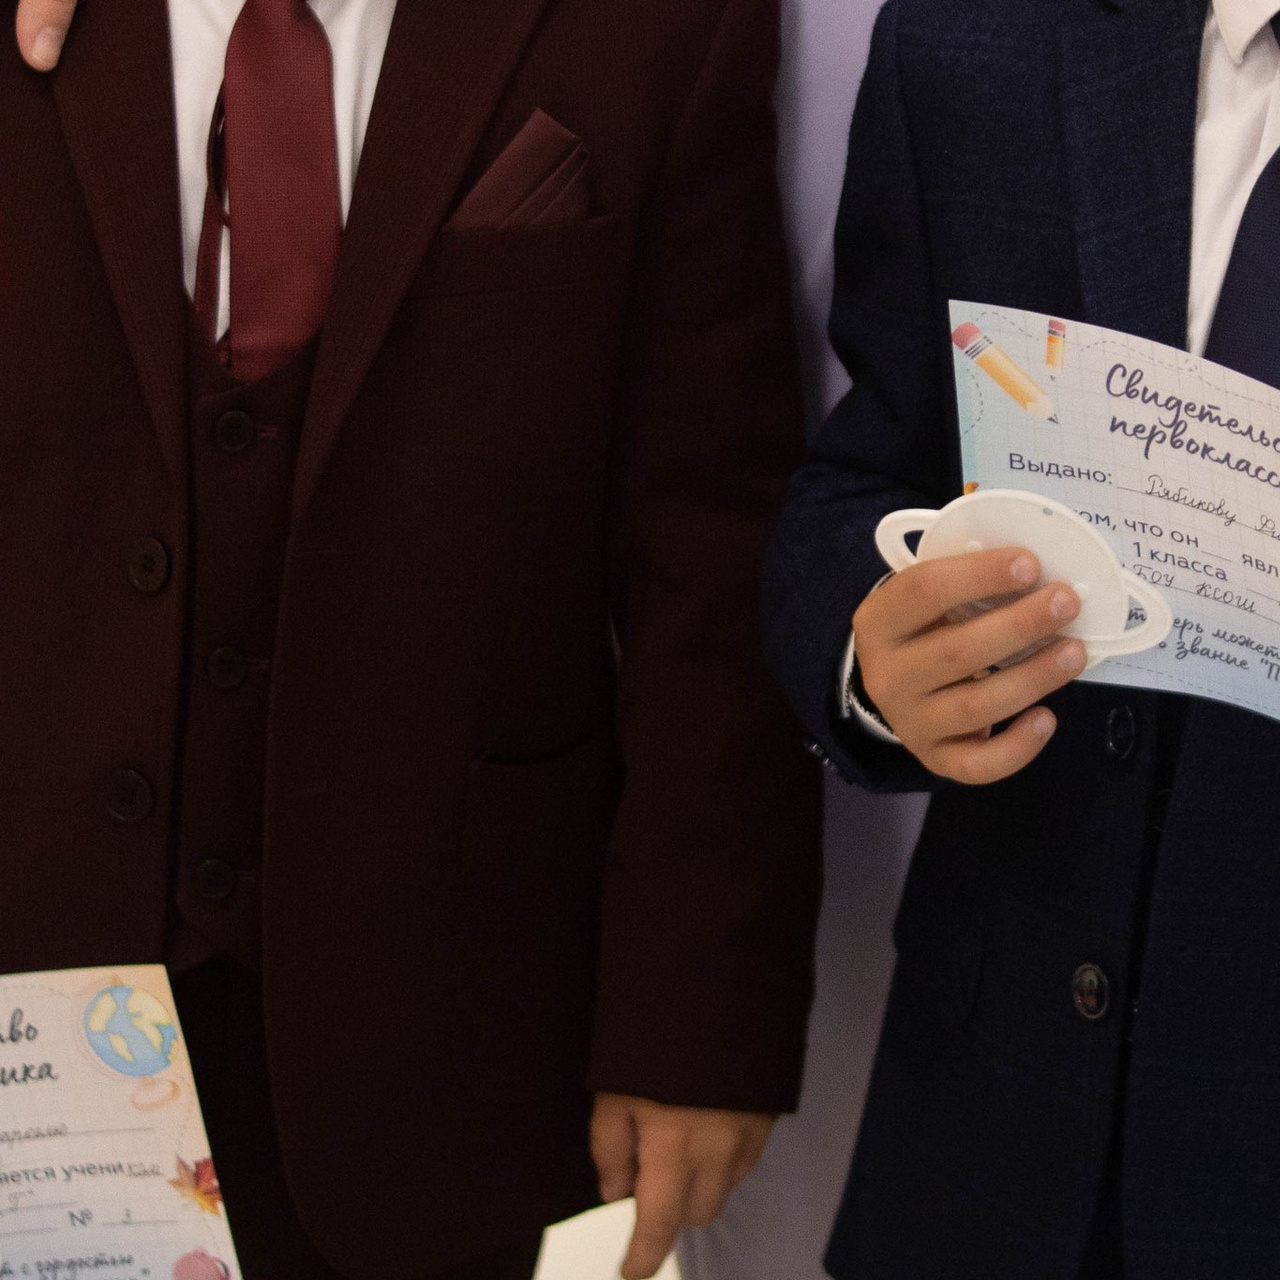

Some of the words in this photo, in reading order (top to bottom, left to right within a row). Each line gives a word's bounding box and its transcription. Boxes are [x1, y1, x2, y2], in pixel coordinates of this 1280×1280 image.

[1009, 452, 1113, 485] Выдано:
[1074, 508, 1117, 531] ом,
[1123, 517, 1164, 538] что
[1170, 530, 1199, 549] он
[1132, 541, 1142, 558] 1
[1149, 548, 1229, 582] класса
[1175, 635, 1251, 671] звание
